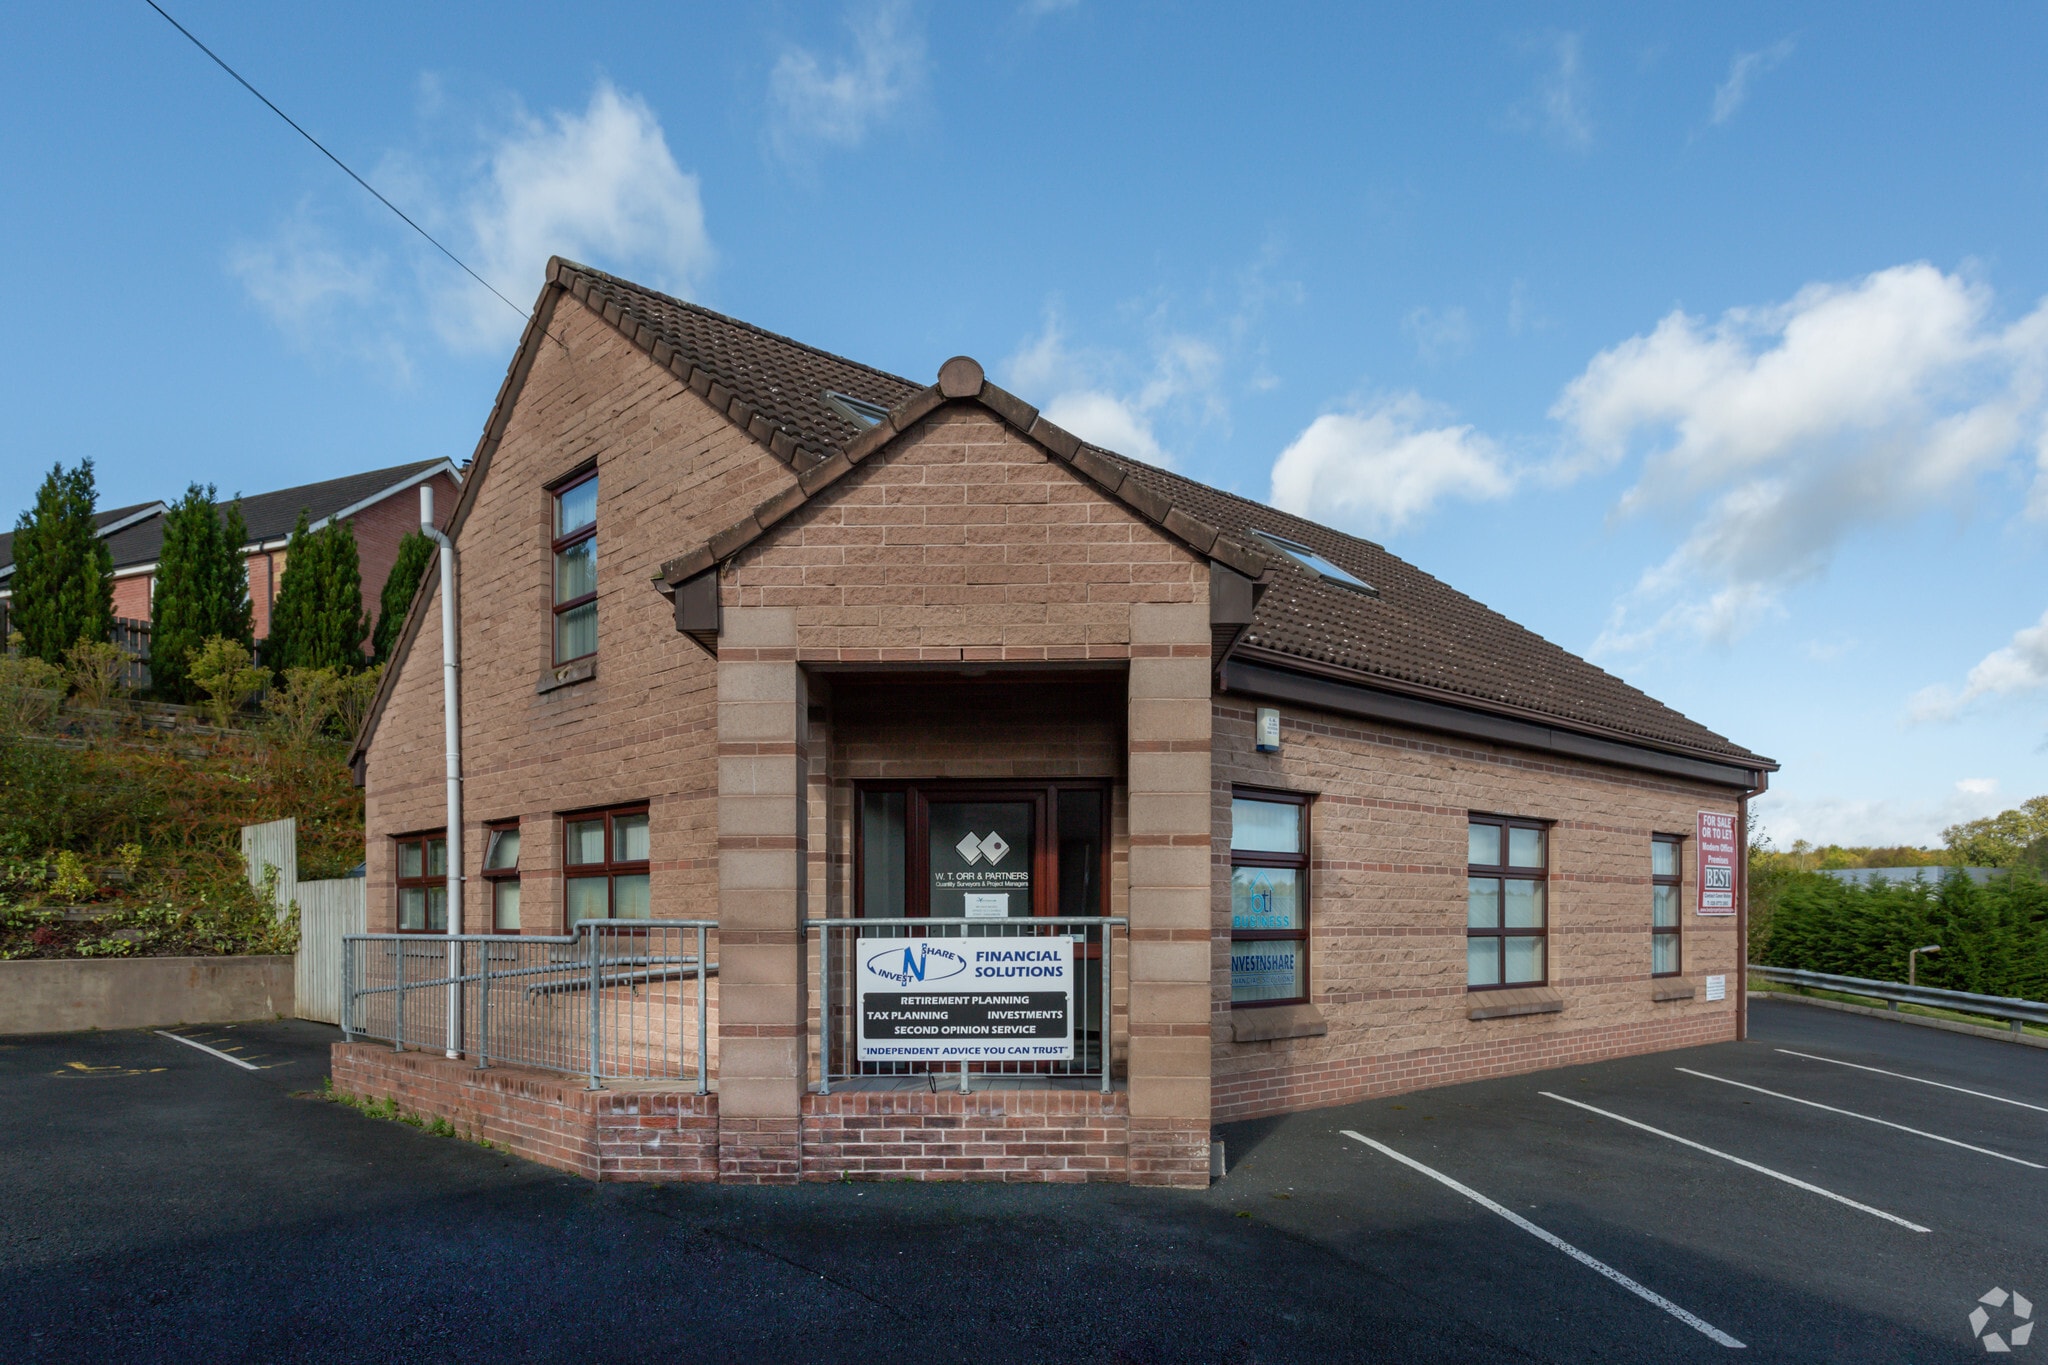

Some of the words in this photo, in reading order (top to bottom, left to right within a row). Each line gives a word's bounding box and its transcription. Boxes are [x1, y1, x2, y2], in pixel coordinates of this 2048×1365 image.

[1703, 815, 1716, 827] FOR
[1716, 816, 1731, 828] SALE
[1702, 826, 1711, 838] OR
[1712, 828, 1721, 839] TO
[1722, 829, 1732, 840] LET
[1702, 842, 1719, 851] Modern
[935, 872, 945, 880] W.
[947, 872, 954, 880] T.
[956, 872, 975, 880] ORR
[977, 872, 983, 880] &
[985, 872, 1029, 880] PARTNERS
[1707, 868, 1730, 887] BEST
[1251, 888, 1272, 913] btl
[1234, 915, 1289, 927] BUSINESS
[976, 950, 1061, 962] FINANCIAL
[878, 968, 914, 984] INVEST
[902, 943, 928, 987] N
[922, 945, 955, 960] SHARE
[1232, 954, 1294, 972] NVESTNSHARE
[975, 966, 1063, 978] SOLUTIONS
[1232, 976, 1258, 985] INANCIAL
[901, 996, 970, 1005] RETIREMENT
[972, 995, 1029, 1004] PLANNING
[867, 1011, 889, 1020] TAX
[891, 1011, 949, 1020] PLANNING
[988, 1010, 1063, 1019] INVESTMENTS
[894, 1026, 939, 1035] SECOND
[941, 1026, 989, 1035] OPINION
[991, 1025, 1036, 1034] SERVICE
[860, 1047, 940, 1055] "INDEPENDENT
[942, 1047, 983, 1055] ADVICE
[983, 1046, 1006, 1055] YOU
[1007, 1046, 1030, 1055] CAN
[1032, 1046, 1068, 1055] TRUST"
